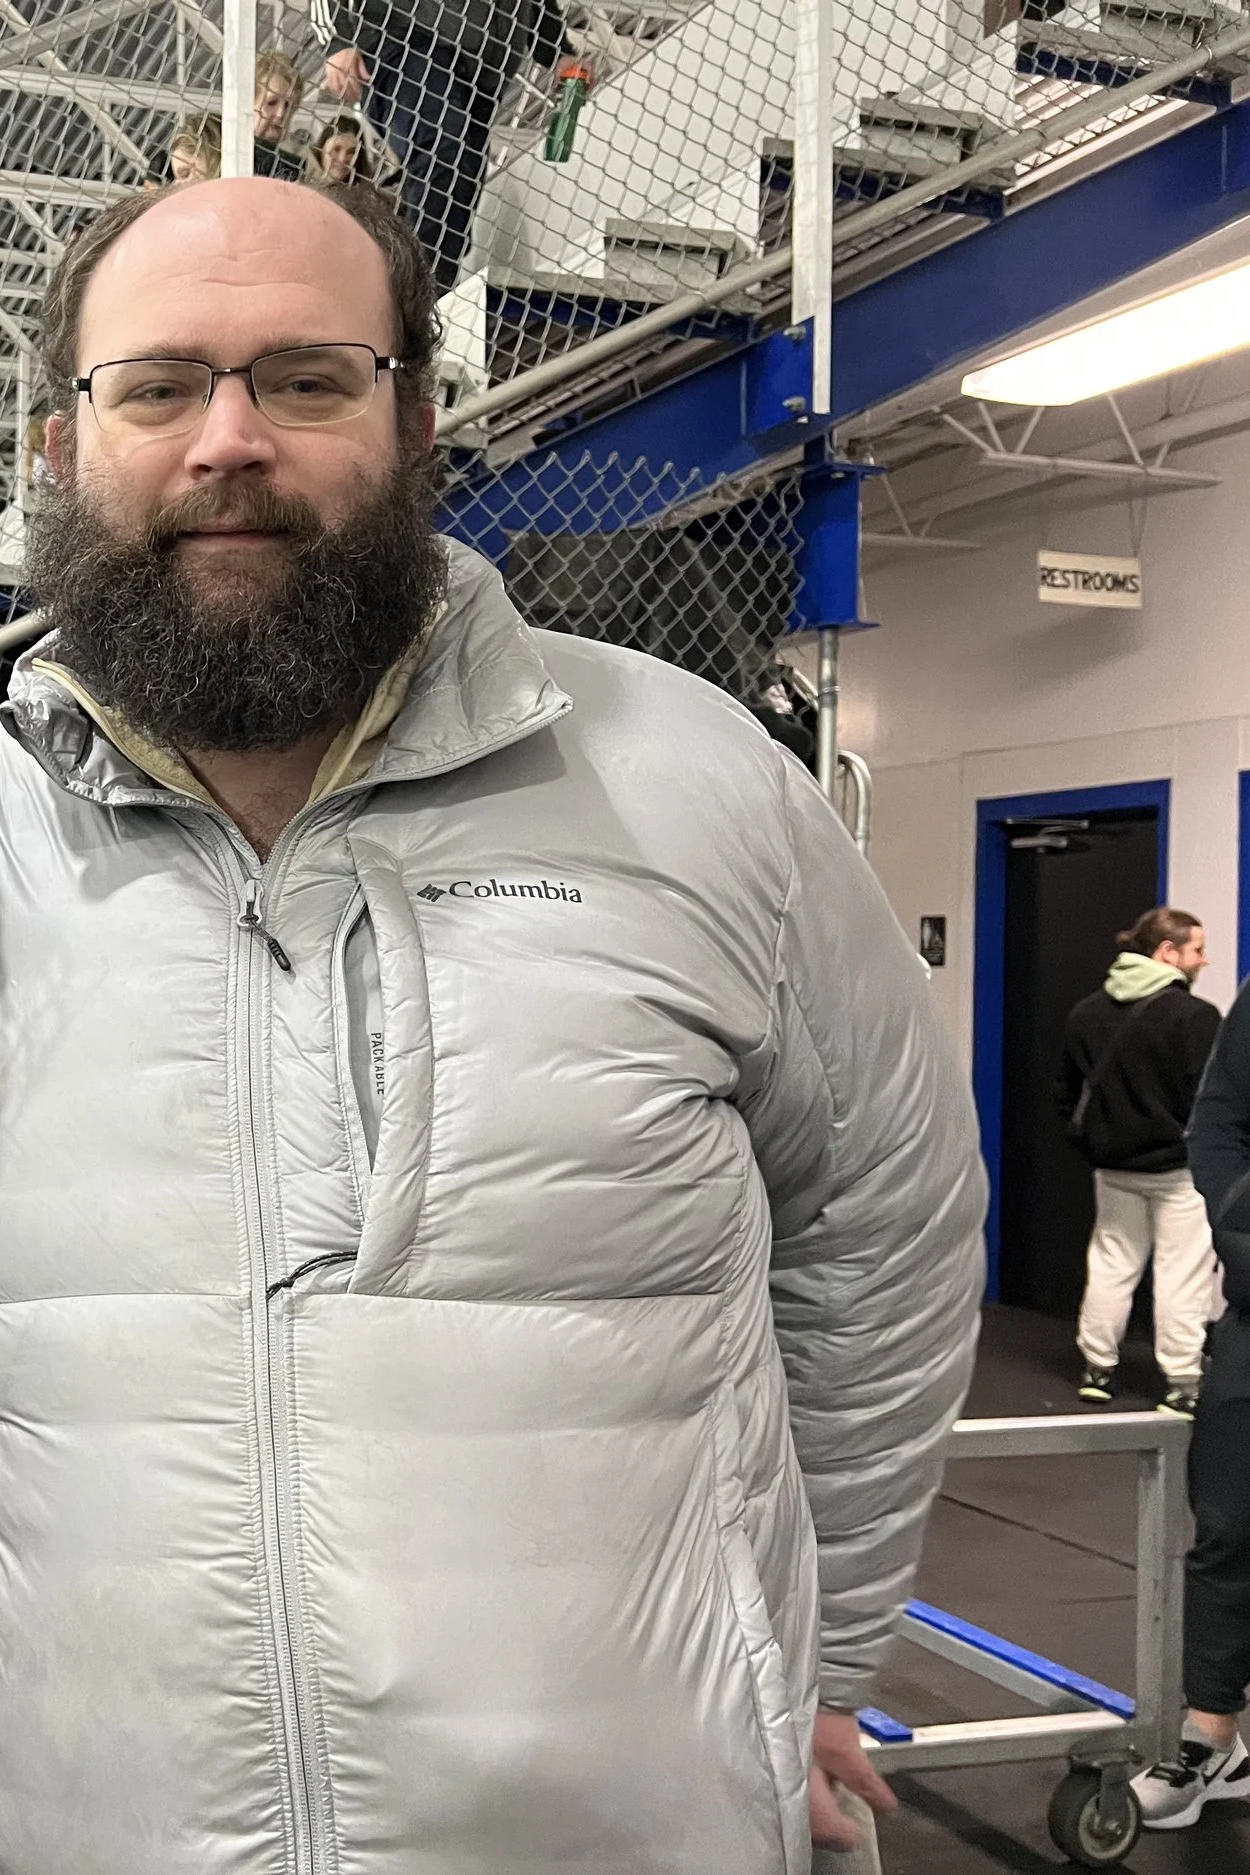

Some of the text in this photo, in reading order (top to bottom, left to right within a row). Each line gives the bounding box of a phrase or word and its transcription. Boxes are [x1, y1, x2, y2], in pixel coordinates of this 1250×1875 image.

[1039, 567, 1140, 593] RESTROOMS
[448, 878, 583, 903] Columbia
[370, 1032, 385, 1095] PACKABLE
